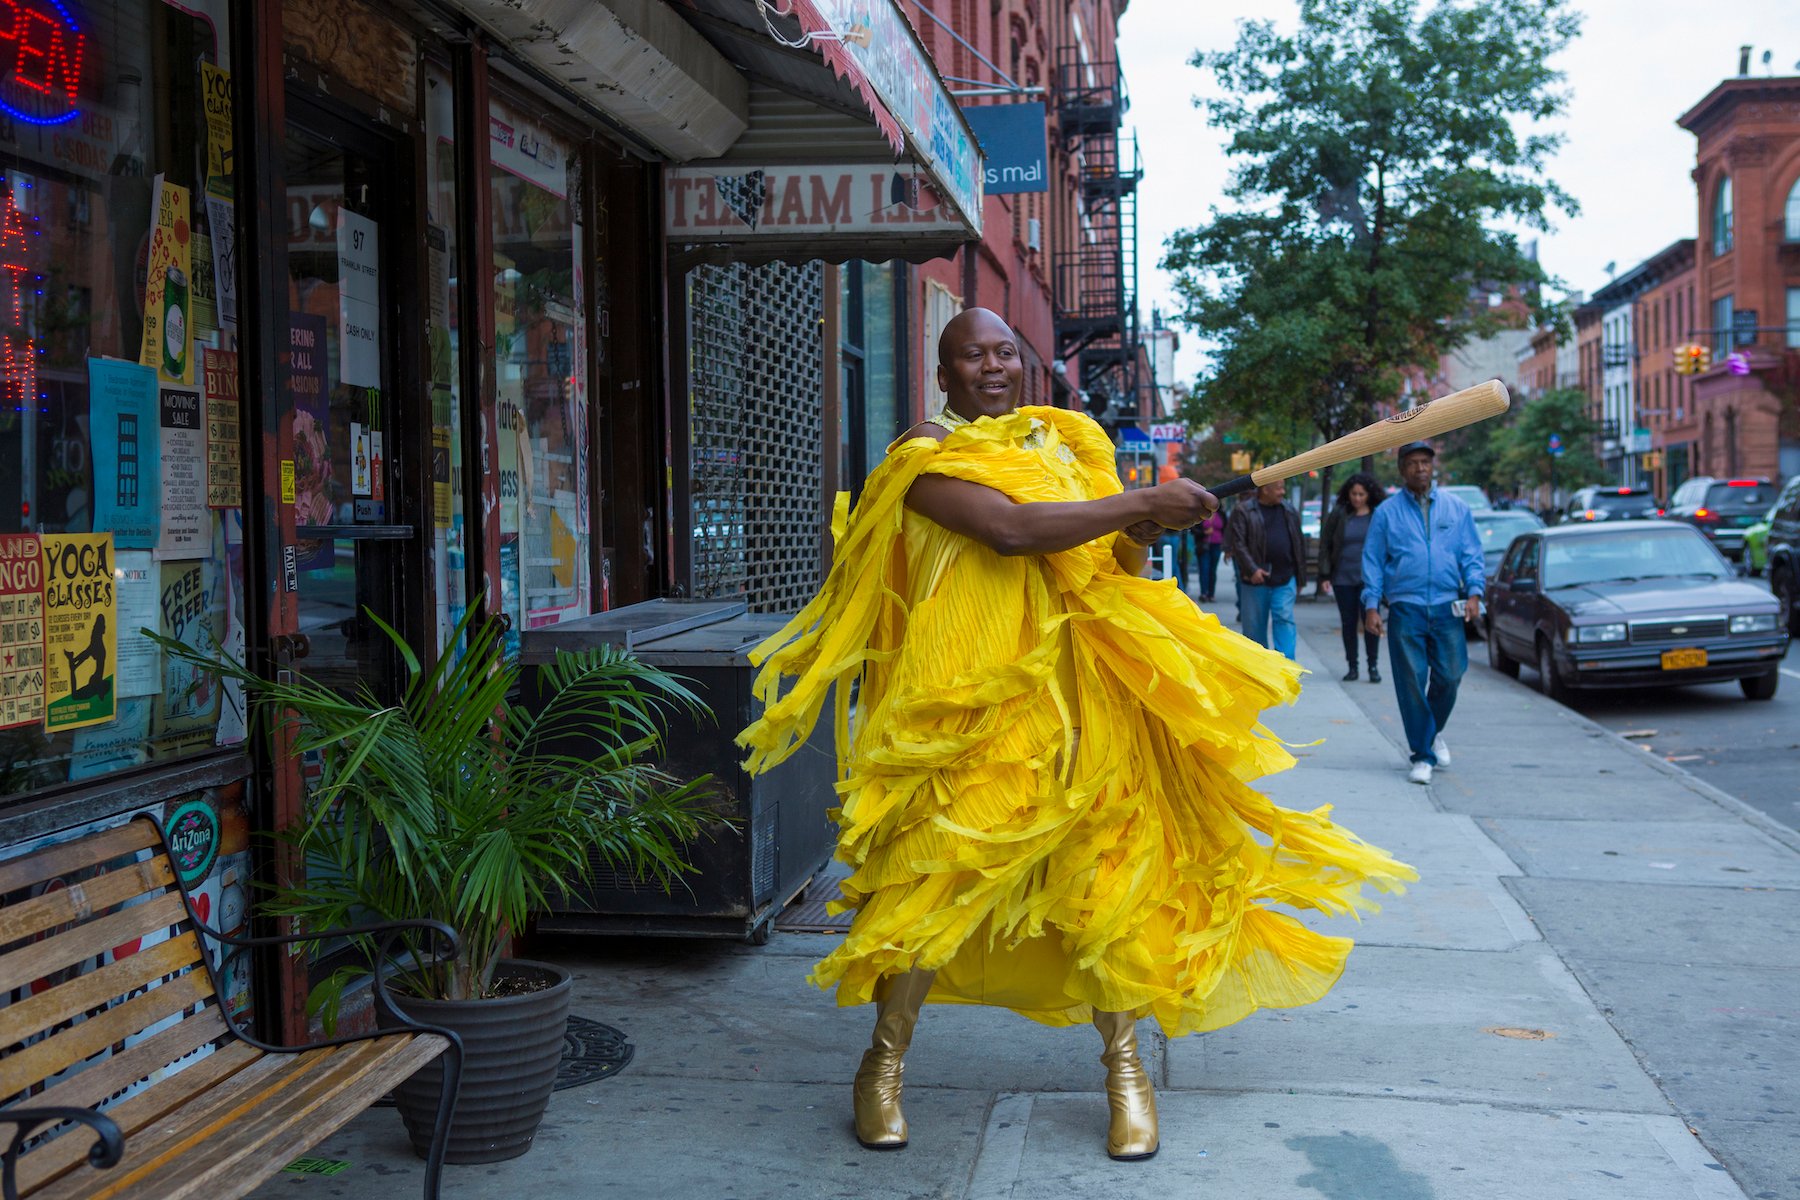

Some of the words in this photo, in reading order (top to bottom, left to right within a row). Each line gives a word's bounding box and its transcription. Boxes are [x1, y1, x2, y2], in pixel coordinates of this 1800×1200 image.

[1003, 159, 1042, 182] mal
[354, 229, 366, 251] 97
[341, 257, 361, 272] FRANKLIN
[362, 265, 377, 277] STREET
[290, 327, 315, 348] ERING
[346, 323, 360, 337] CASH
[361, 327, 376, 342] ONLY
[297, 351, 313, 370] ALL
[164, 394, 196, 410] MOVING
[172, 411, 189, 426] SALE
[1153, 427, 1184, 439] ATM
[357, 504, 372, 517] Push
[124, 570, 147, 580] NOTICE
[47, 580, 112, 609] CLASSES
[161, 567, 200, 630] FREE
[32, 671, 43, 691] TO
[50, 667, 59, 678] THE
[50, 680, 68, 693] STUDIO
[171, 828, 211, 852] AriZona
